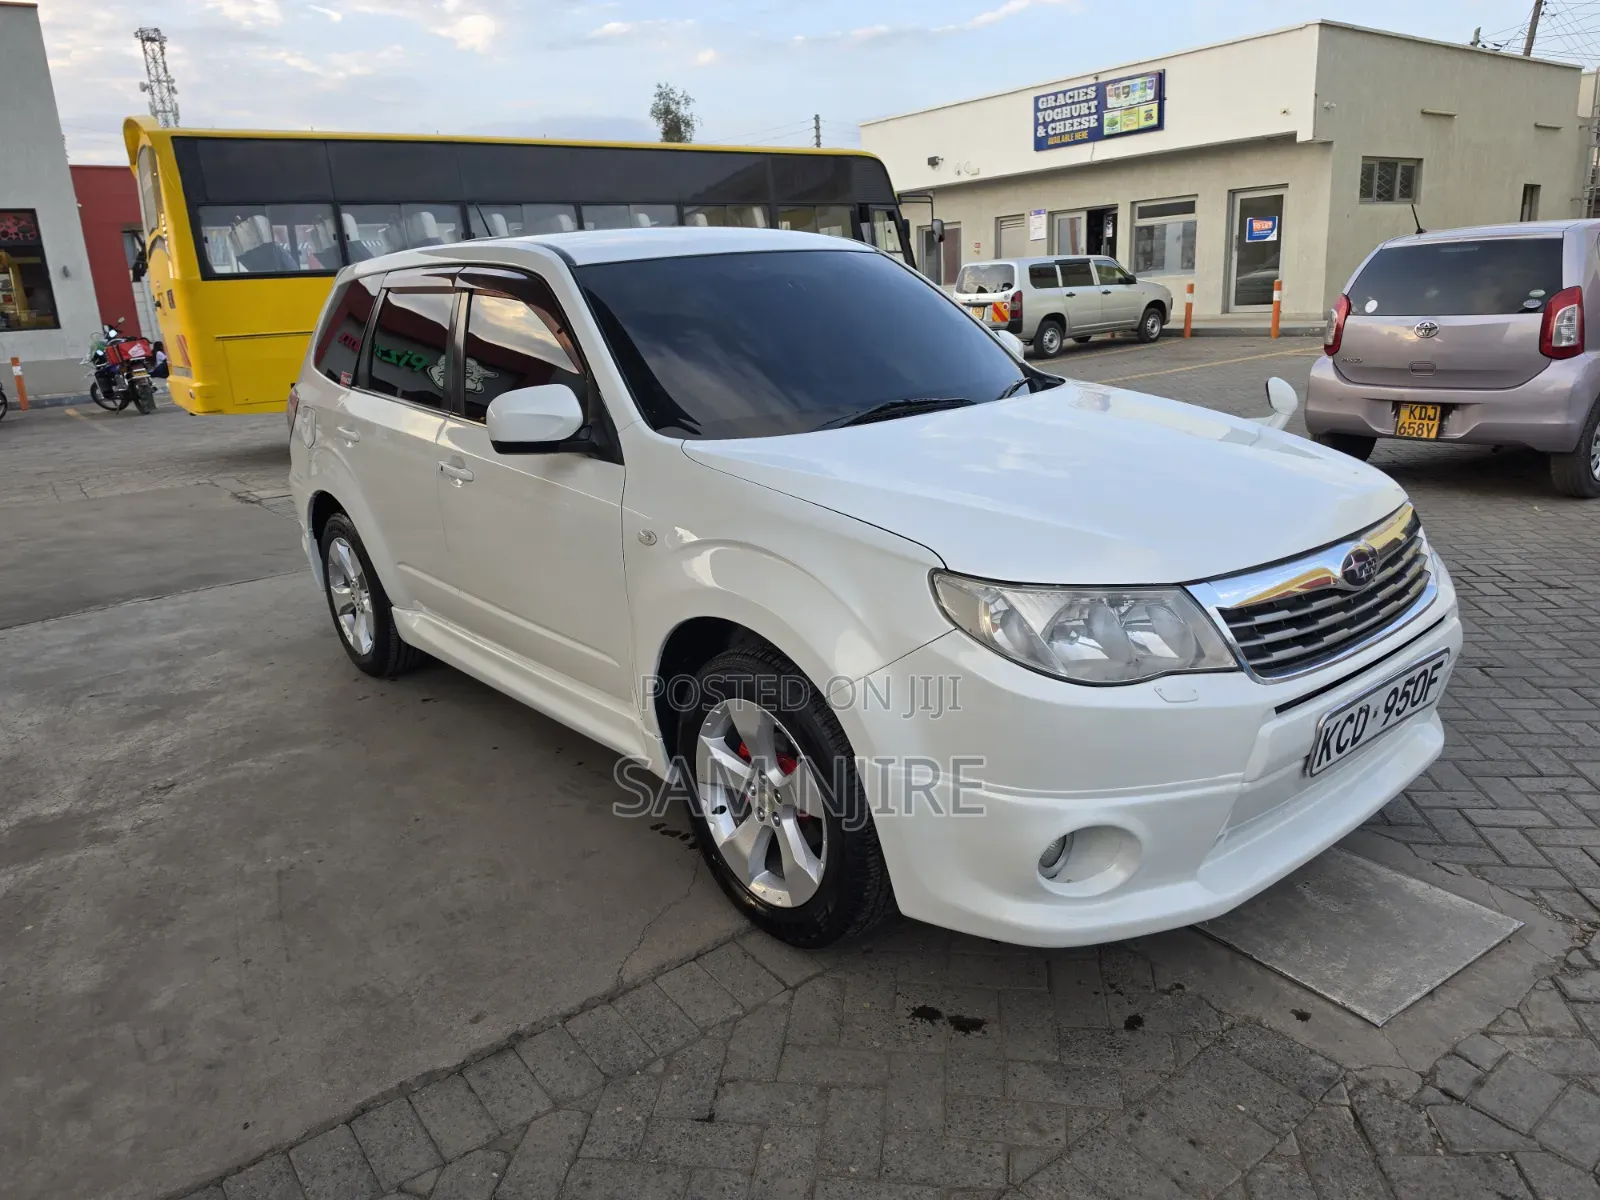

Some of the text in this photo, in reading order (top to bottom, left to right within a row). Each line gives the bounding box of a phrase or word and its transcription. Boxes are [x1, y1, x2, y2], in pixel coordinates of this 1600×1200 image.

[1038, 86, 1096, 109] GRACIES
[1037, 100, 1098, 123] YOGHURT
[1036, 115, 1098, 138] & CHEESE
[1047, 130, 1089, 145] AVAILABLE HERE
[1408, 404, 1438, 421] KDJ
[1398, 421, 1435, 438] 658Y
